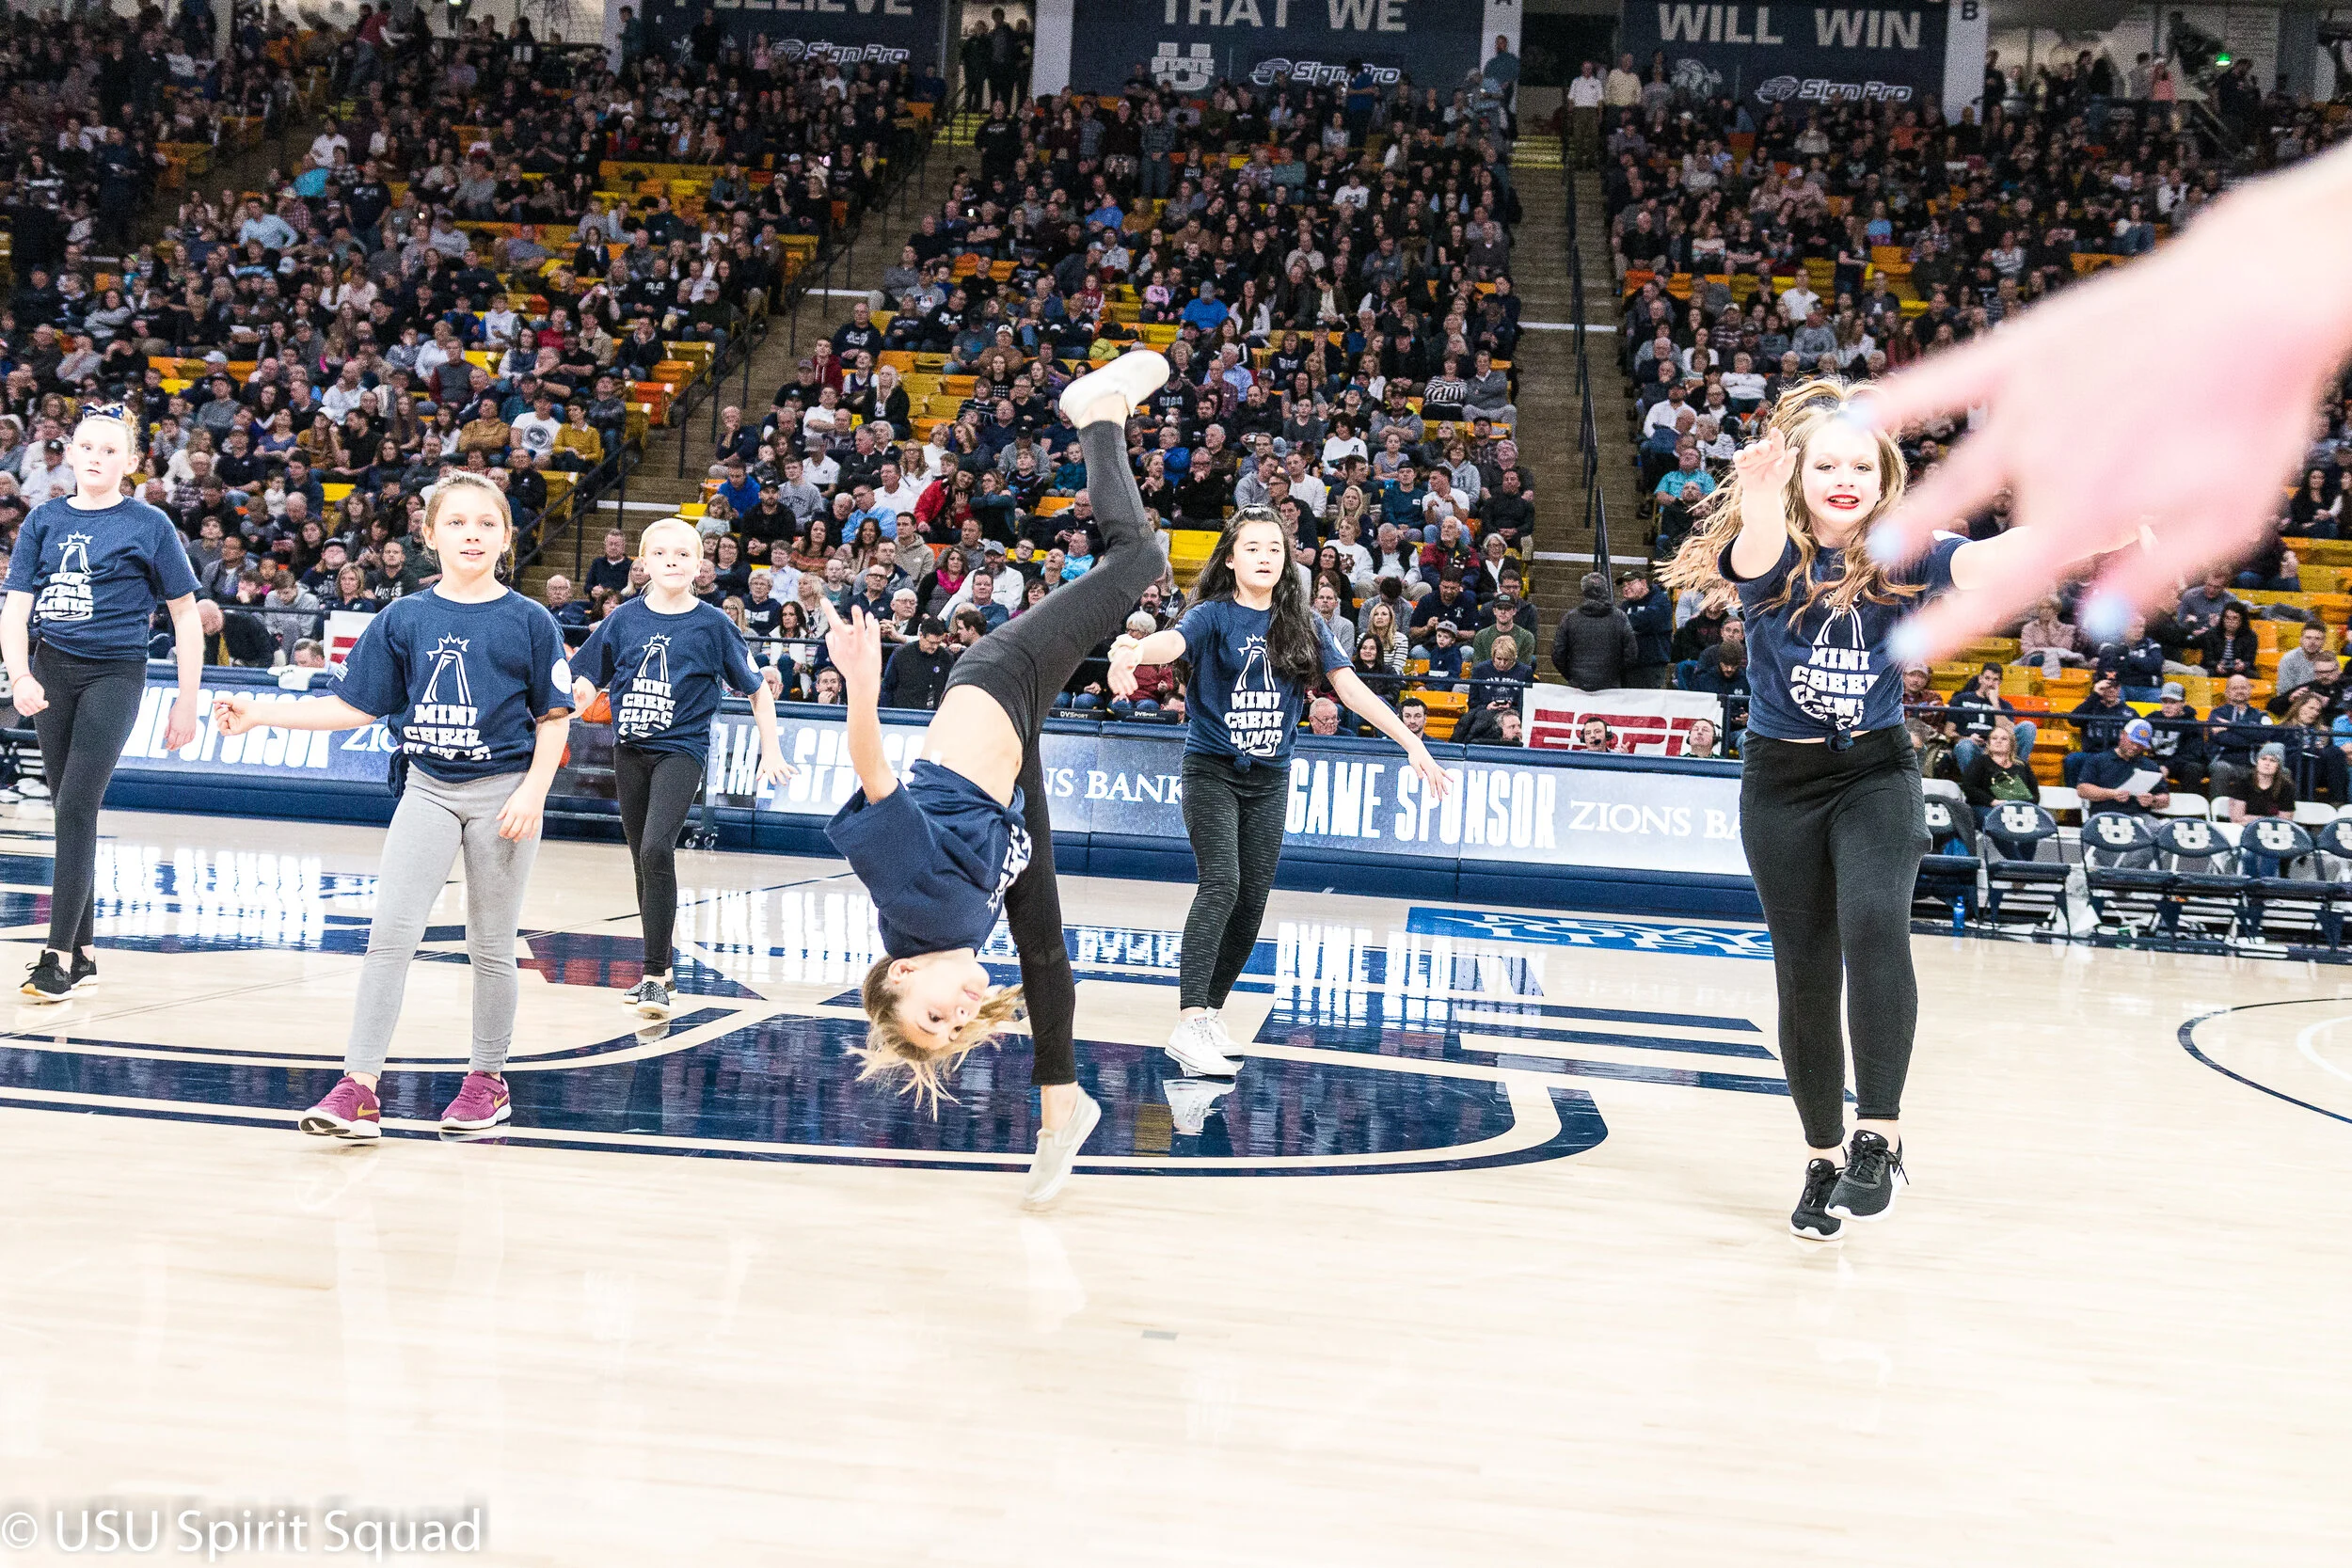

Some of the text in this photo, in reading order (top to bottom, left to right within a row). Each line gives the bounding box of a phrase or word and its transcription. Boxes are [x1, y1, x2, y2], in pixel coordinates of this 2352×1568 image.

[1327, 0, 1407, 31] WE
[1658, 2, 1921, 50] WILL WIN
[1862, 81, 1913, 103] Pro
[1808, 647, 1870, 671] MINI
[632, 678, 672, 698] MINI
[1231, 690, 1281, 710] MINI
[414, 704, 478, 727] MINI
[1224, 711, 1284, 729] CHEER
[340, 723, 400, 753] ZIO
[1284, 757, 1556, 849] GAME SPONSOR
[1568, 799, 1692, 837] ZIONS
